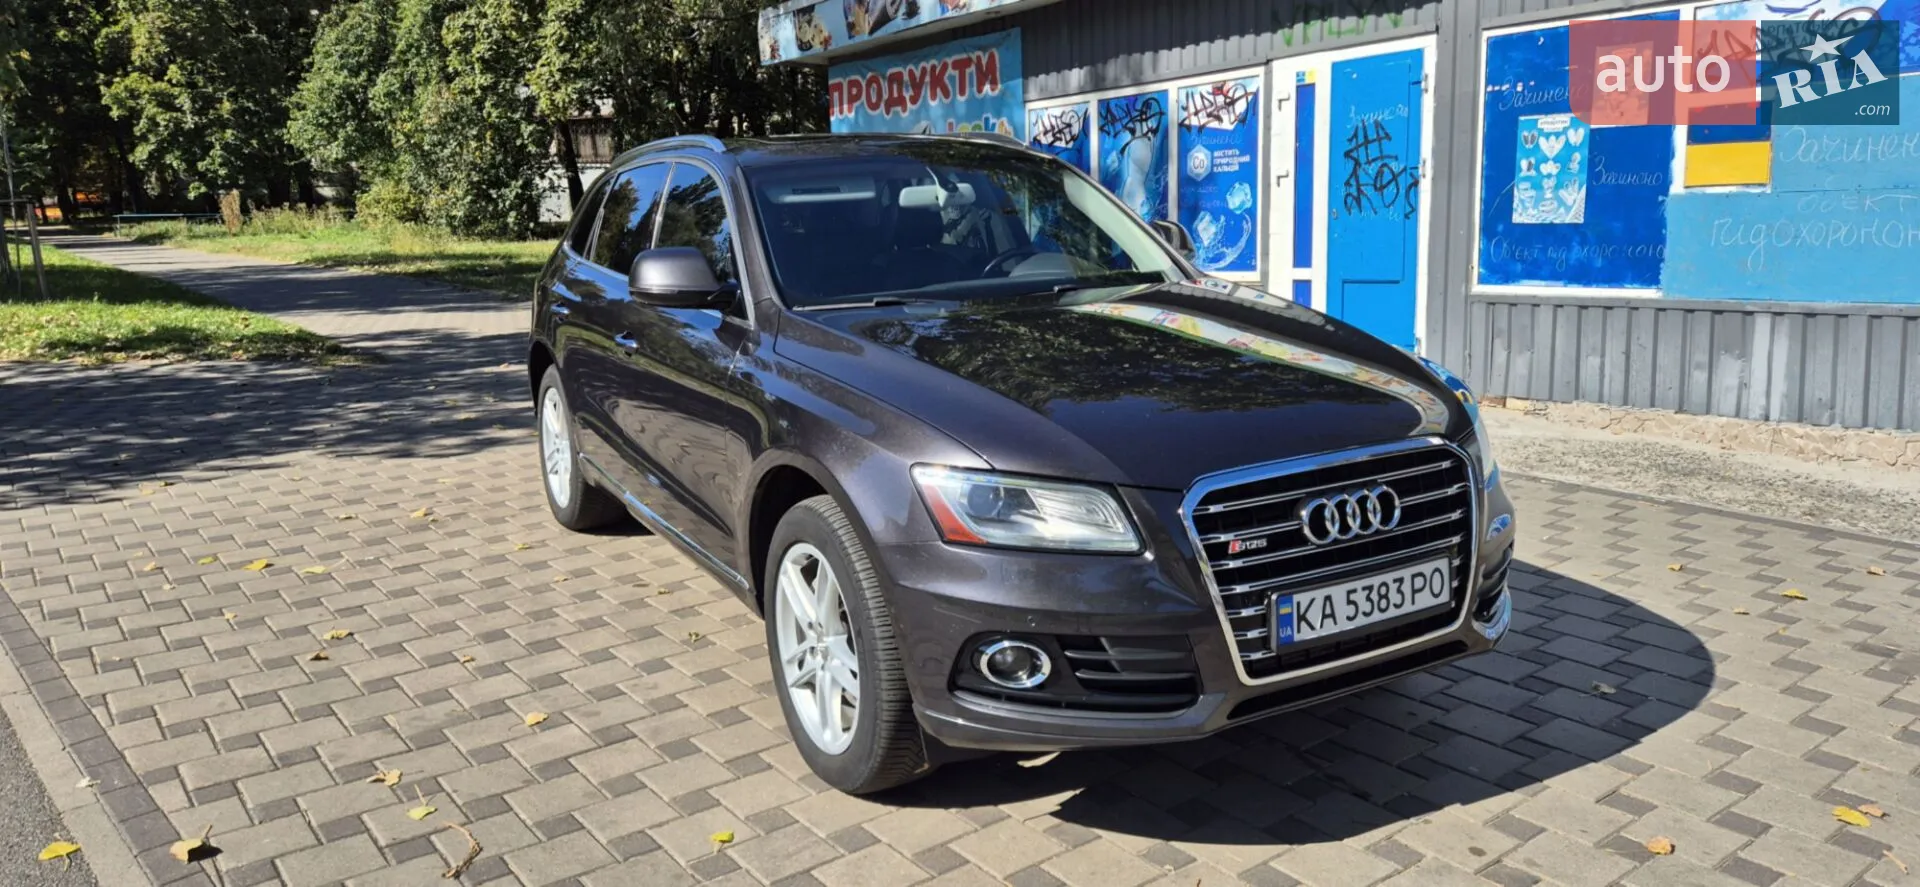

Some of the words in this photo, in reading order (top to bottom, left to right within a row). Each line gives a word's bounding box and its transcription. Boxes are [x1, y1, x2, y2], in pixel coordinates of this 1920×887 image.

[829, 50, 1000, 117] ПРОДУКТИ
[1279, 627, 1293, 638] UA
[1296, 594, 1338, 634] KA
[1345, 577, 1406, 622] 5383
[1411, 567, 1446, 606] PO
